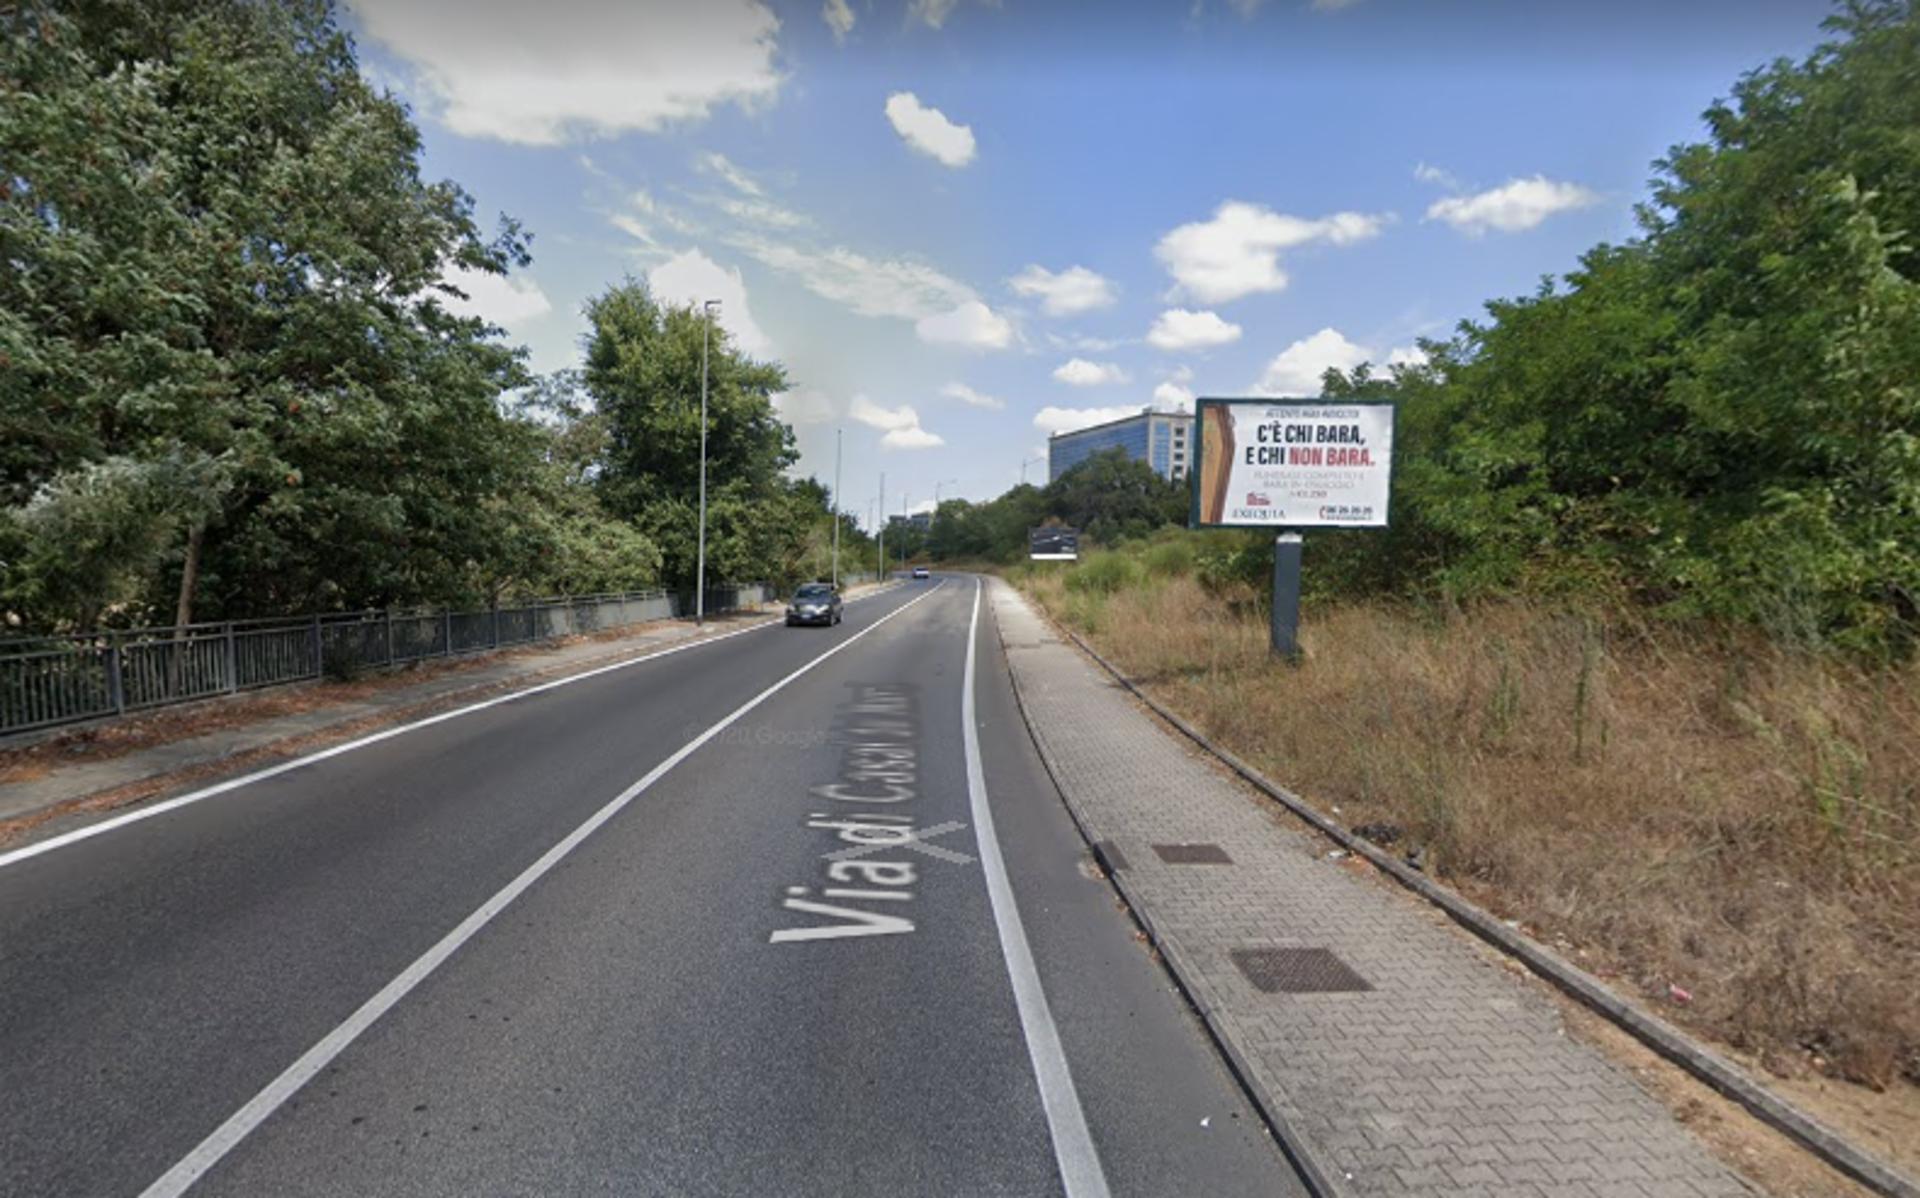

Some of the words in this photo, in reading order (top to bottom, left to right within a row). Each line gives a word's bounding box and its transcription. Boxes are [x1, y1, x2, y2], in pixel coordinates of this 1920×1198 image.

[1257, 421, 1282, 443] C'È
[1285, 425, 1313, 443] CHI
[1316, 425, 1366, 445] BARA,
[1246, 447, 1254, 464] E
[1258, 447, 1285, 464] CHI
[1289, 447, 1322, 465] NON
[1326, 447, 1376, 466] BARA.
